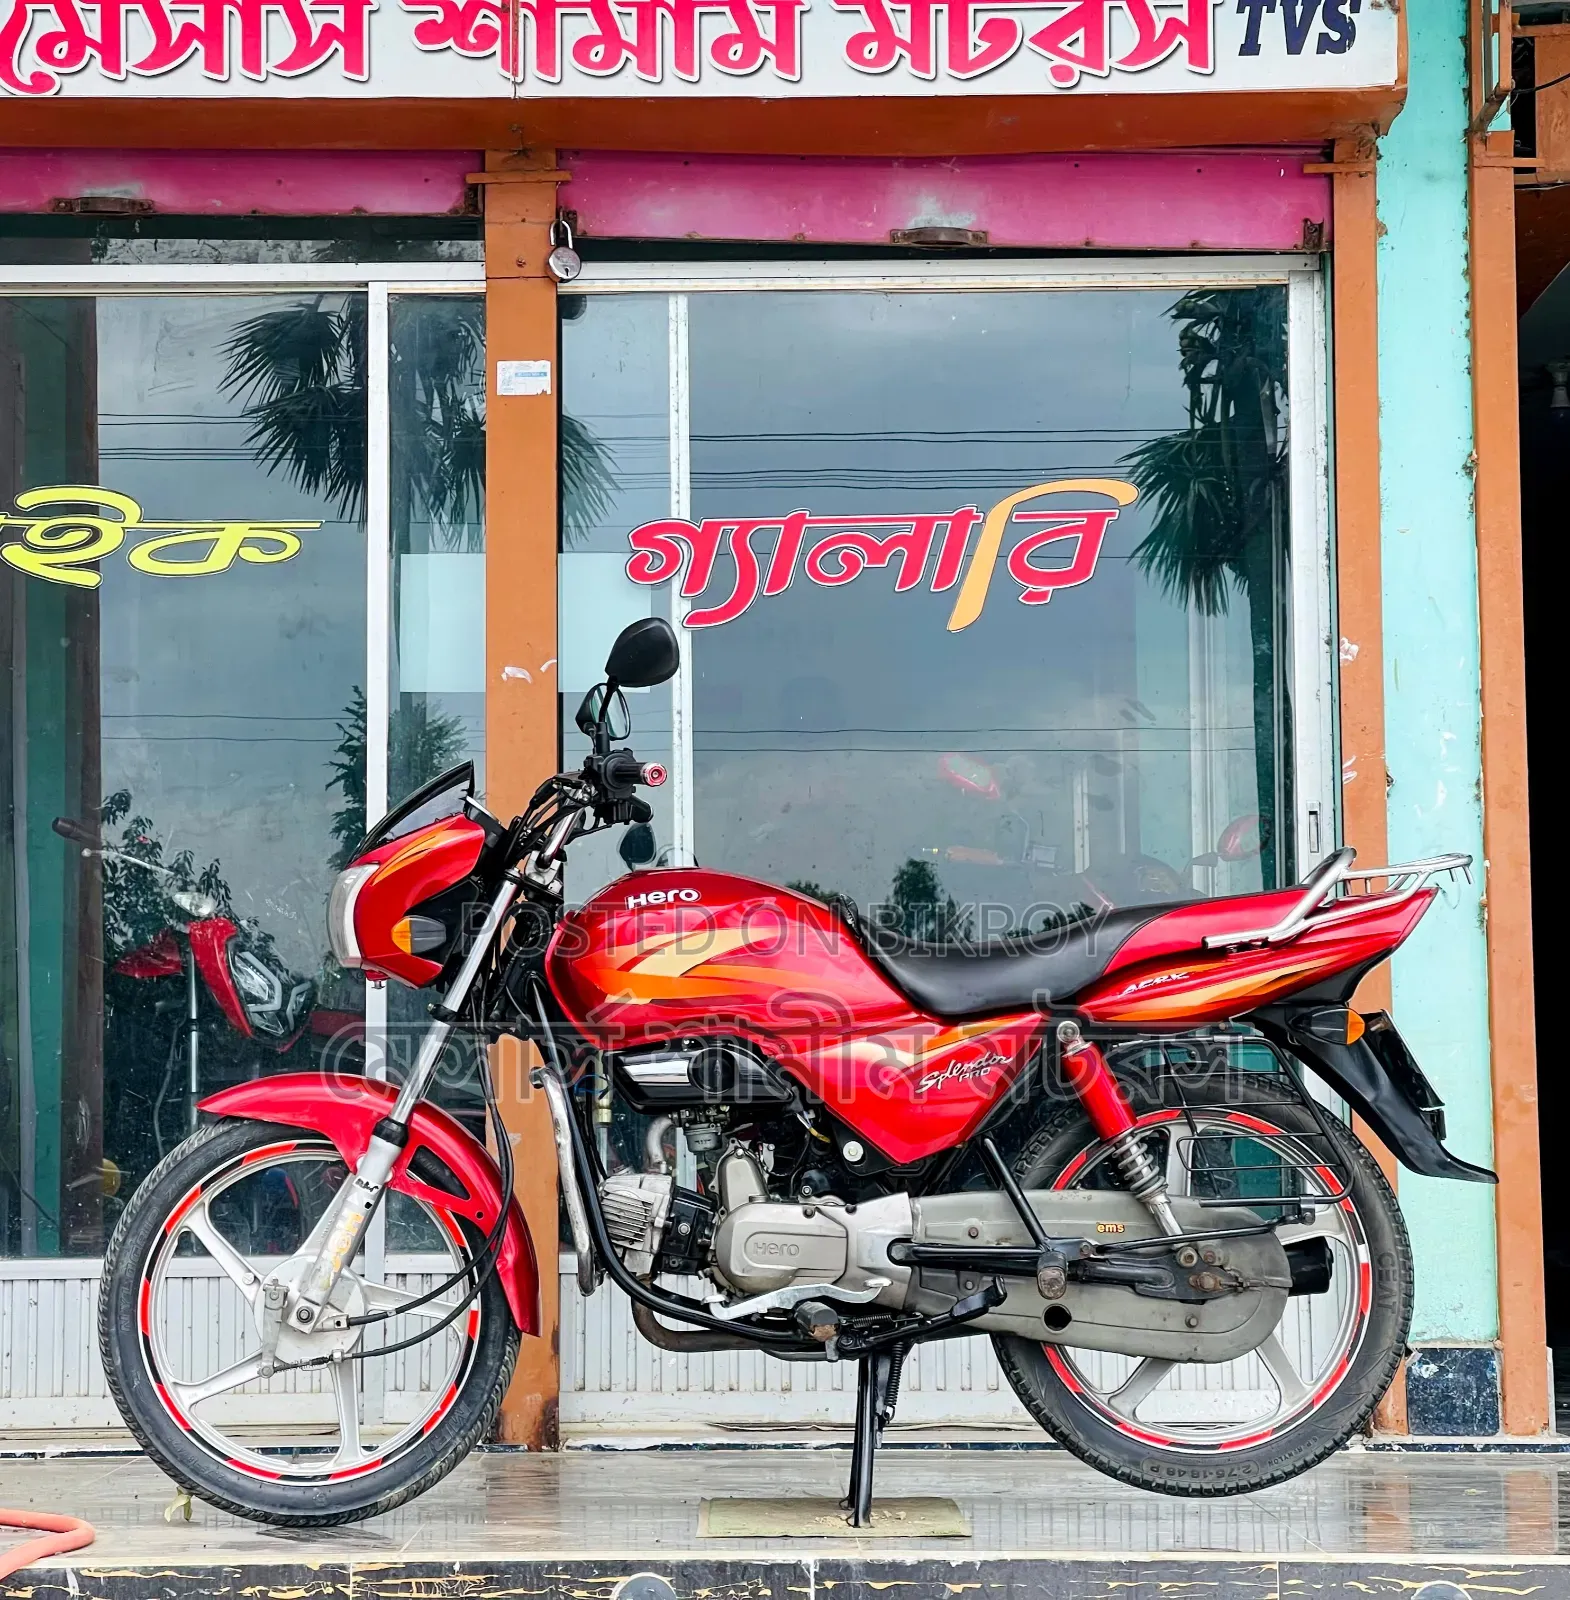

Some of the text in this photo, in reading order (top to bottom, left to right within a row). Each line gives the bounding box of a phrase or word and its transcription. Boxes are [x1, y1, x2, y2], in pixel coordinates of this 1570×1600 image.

[1236, 0, 1361, 57] TVS
[625, 478, 1140, 632] গ্যালারি
[626, 888, 701, 911] Hero
[914, 1050, 1014, 1094] Splendor
[959, 1066, 991, 1082] PRO
[1096, 1223, 1125, 1233] ems
[753, 1242, 800, 1257] Hero
[1376, 1251, 1398, 1315] CEAT
